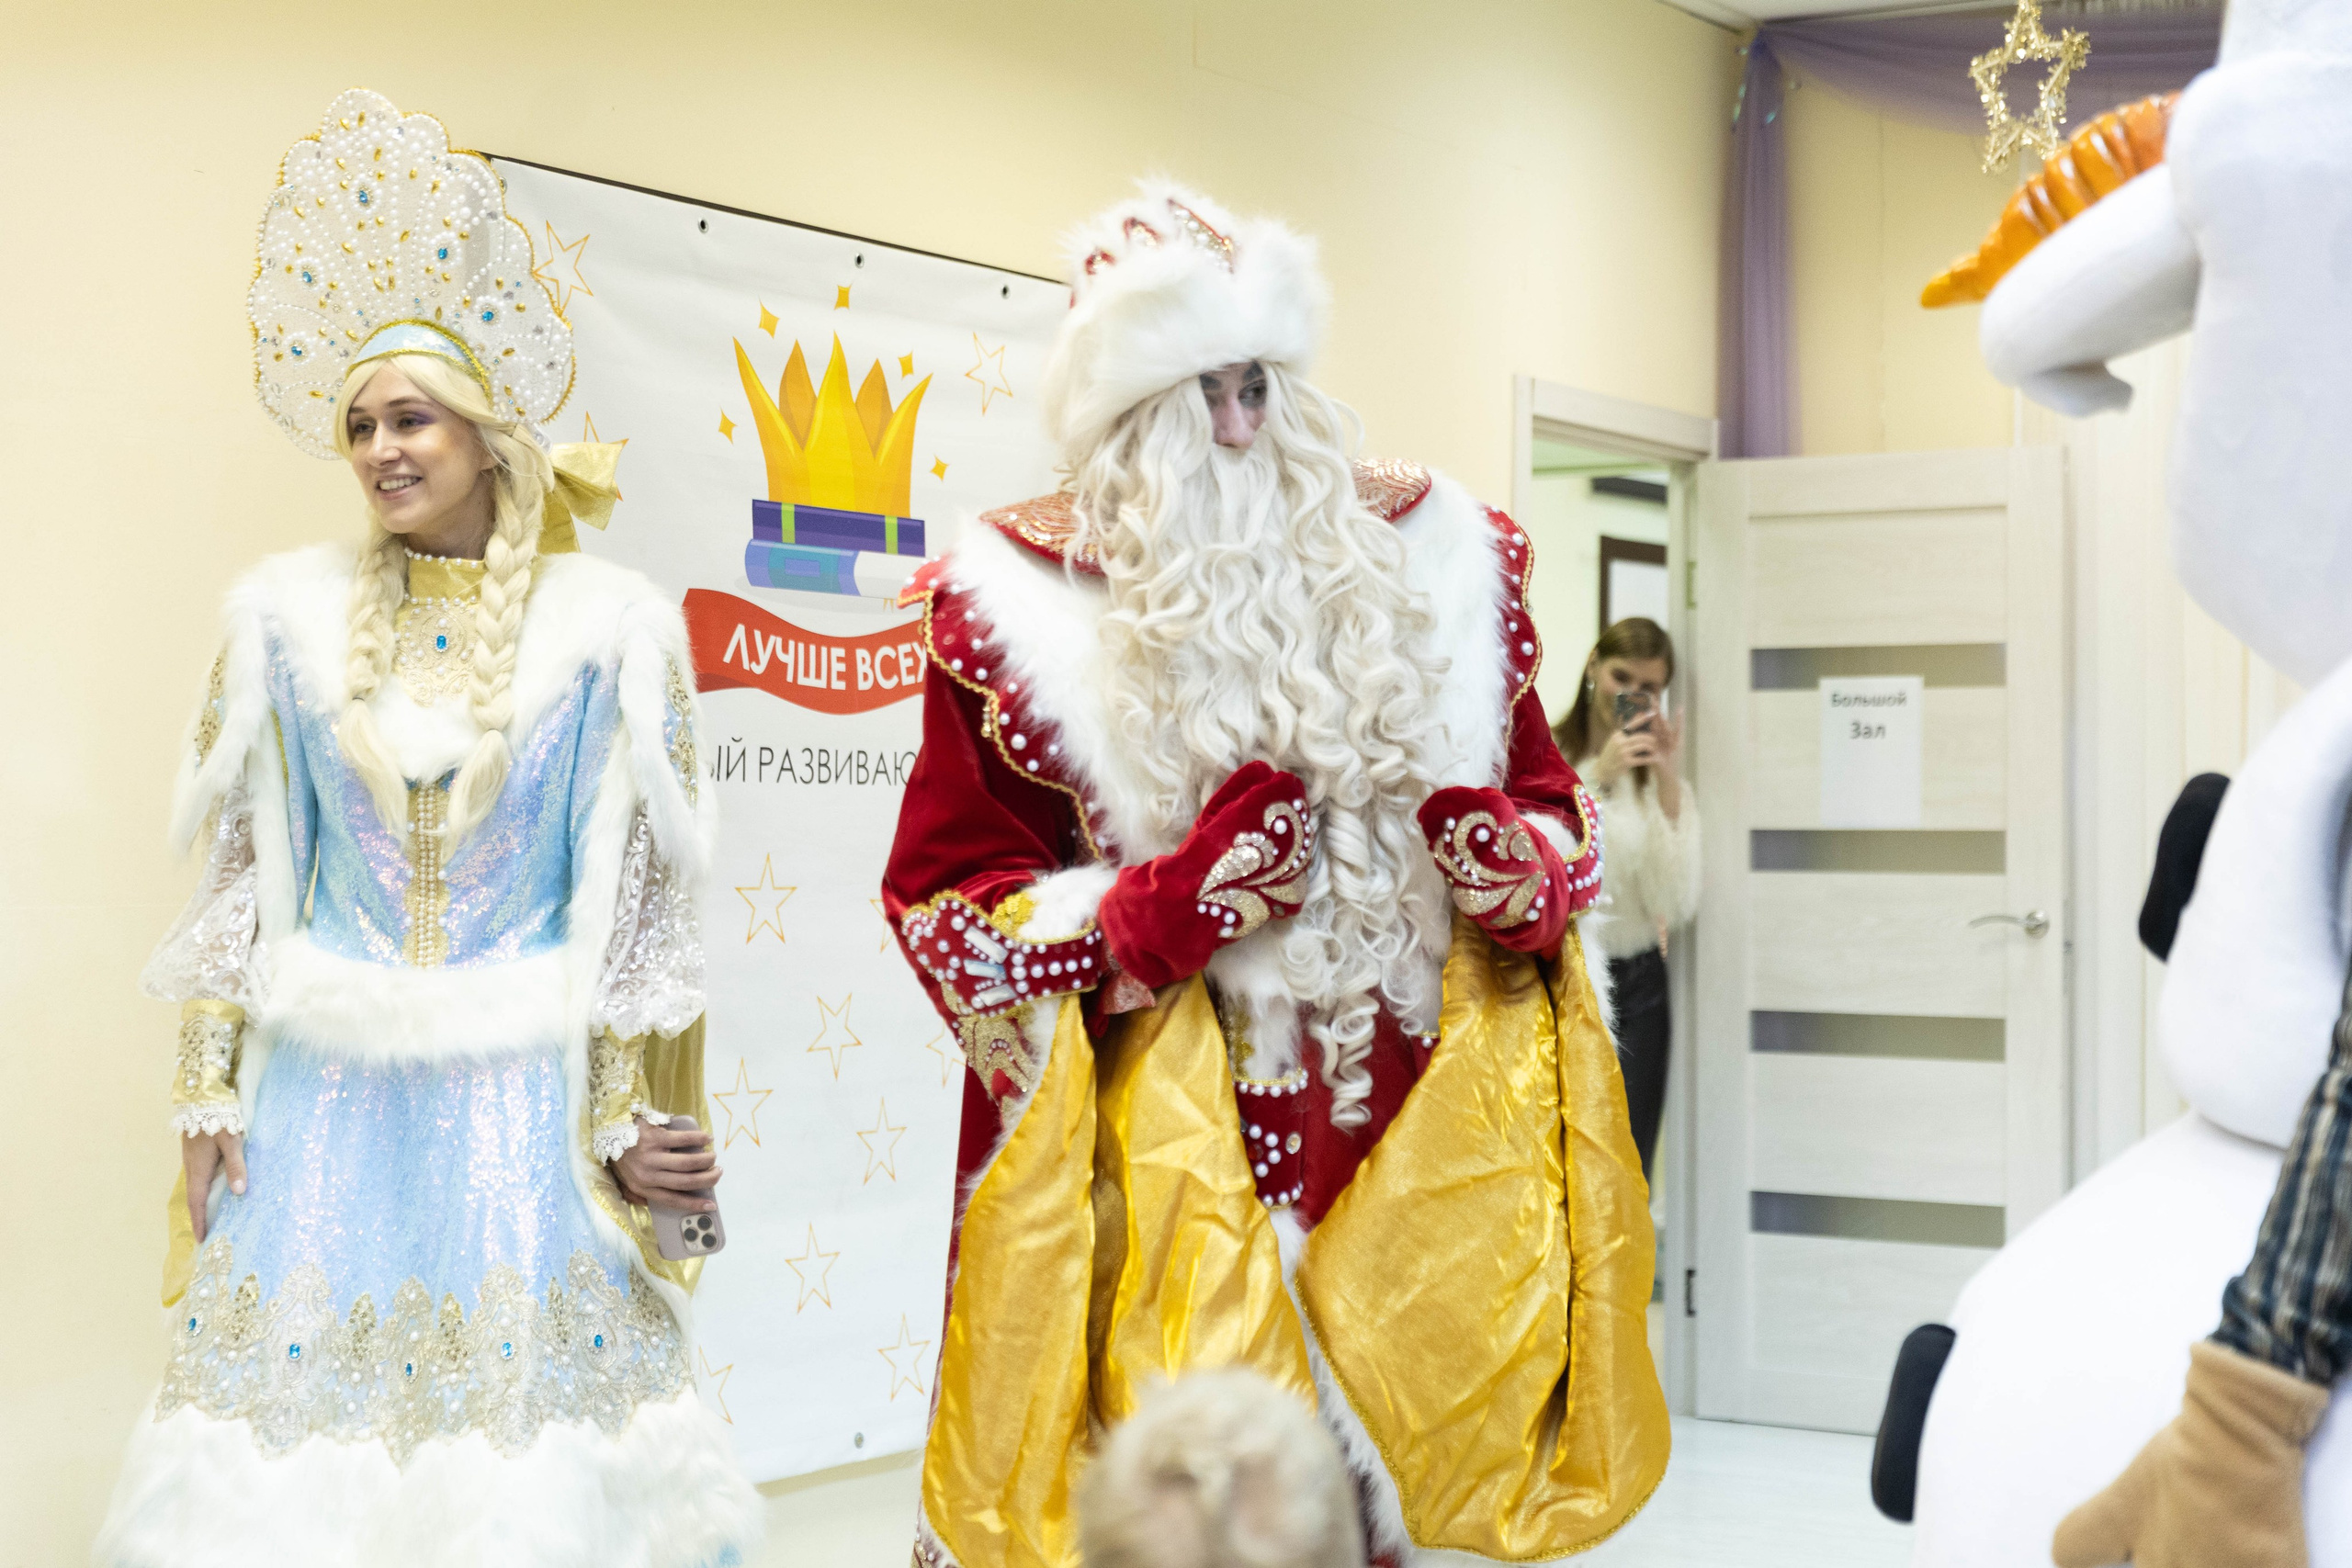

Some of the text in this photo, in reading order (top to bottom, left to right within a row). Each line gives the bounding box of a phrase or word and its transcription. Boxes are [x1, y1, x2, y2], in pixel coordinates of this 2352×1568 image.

[722, 623, 927, 691] ЛУЧШЕ ВСЕХ
[1831, 691, 1907, 707] Большой
[1850, 719, 1886, 739] Зал
[759, 746, 917, 787] РАЗВИВАЮ
